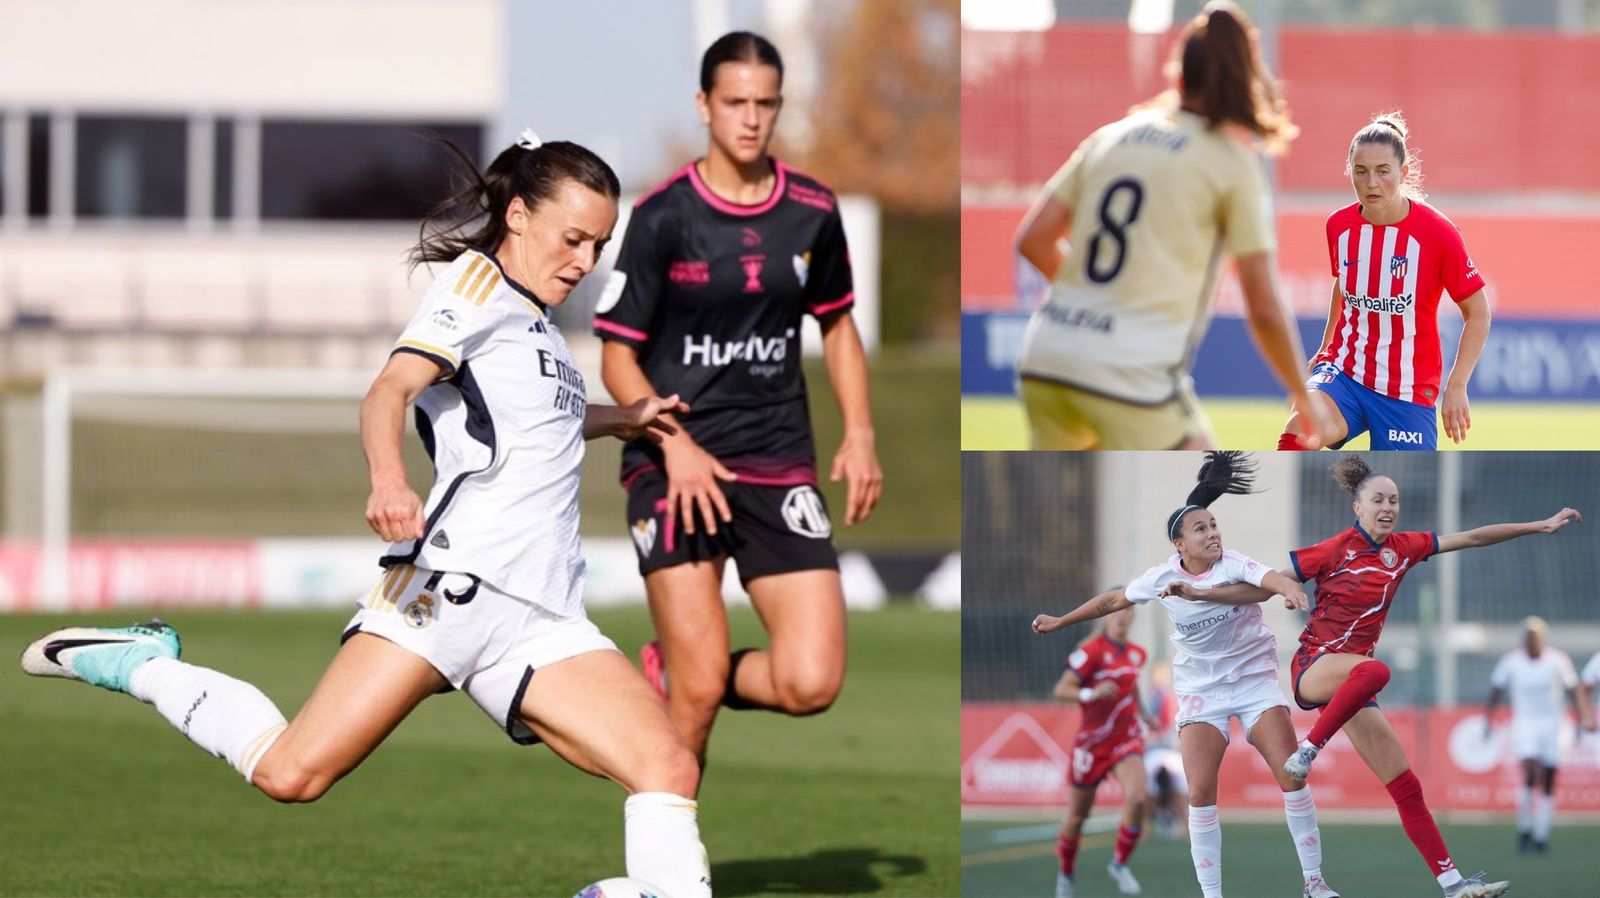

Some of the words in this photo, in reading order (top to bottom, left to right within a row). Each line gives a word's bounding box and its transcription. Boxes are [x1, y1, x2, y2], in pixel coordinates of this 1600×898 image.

[1084, 175, 1144, 285] 8
[1388, 428, 1423, 445] BAXI
[1174, 611, 1231, 633] Thermor
